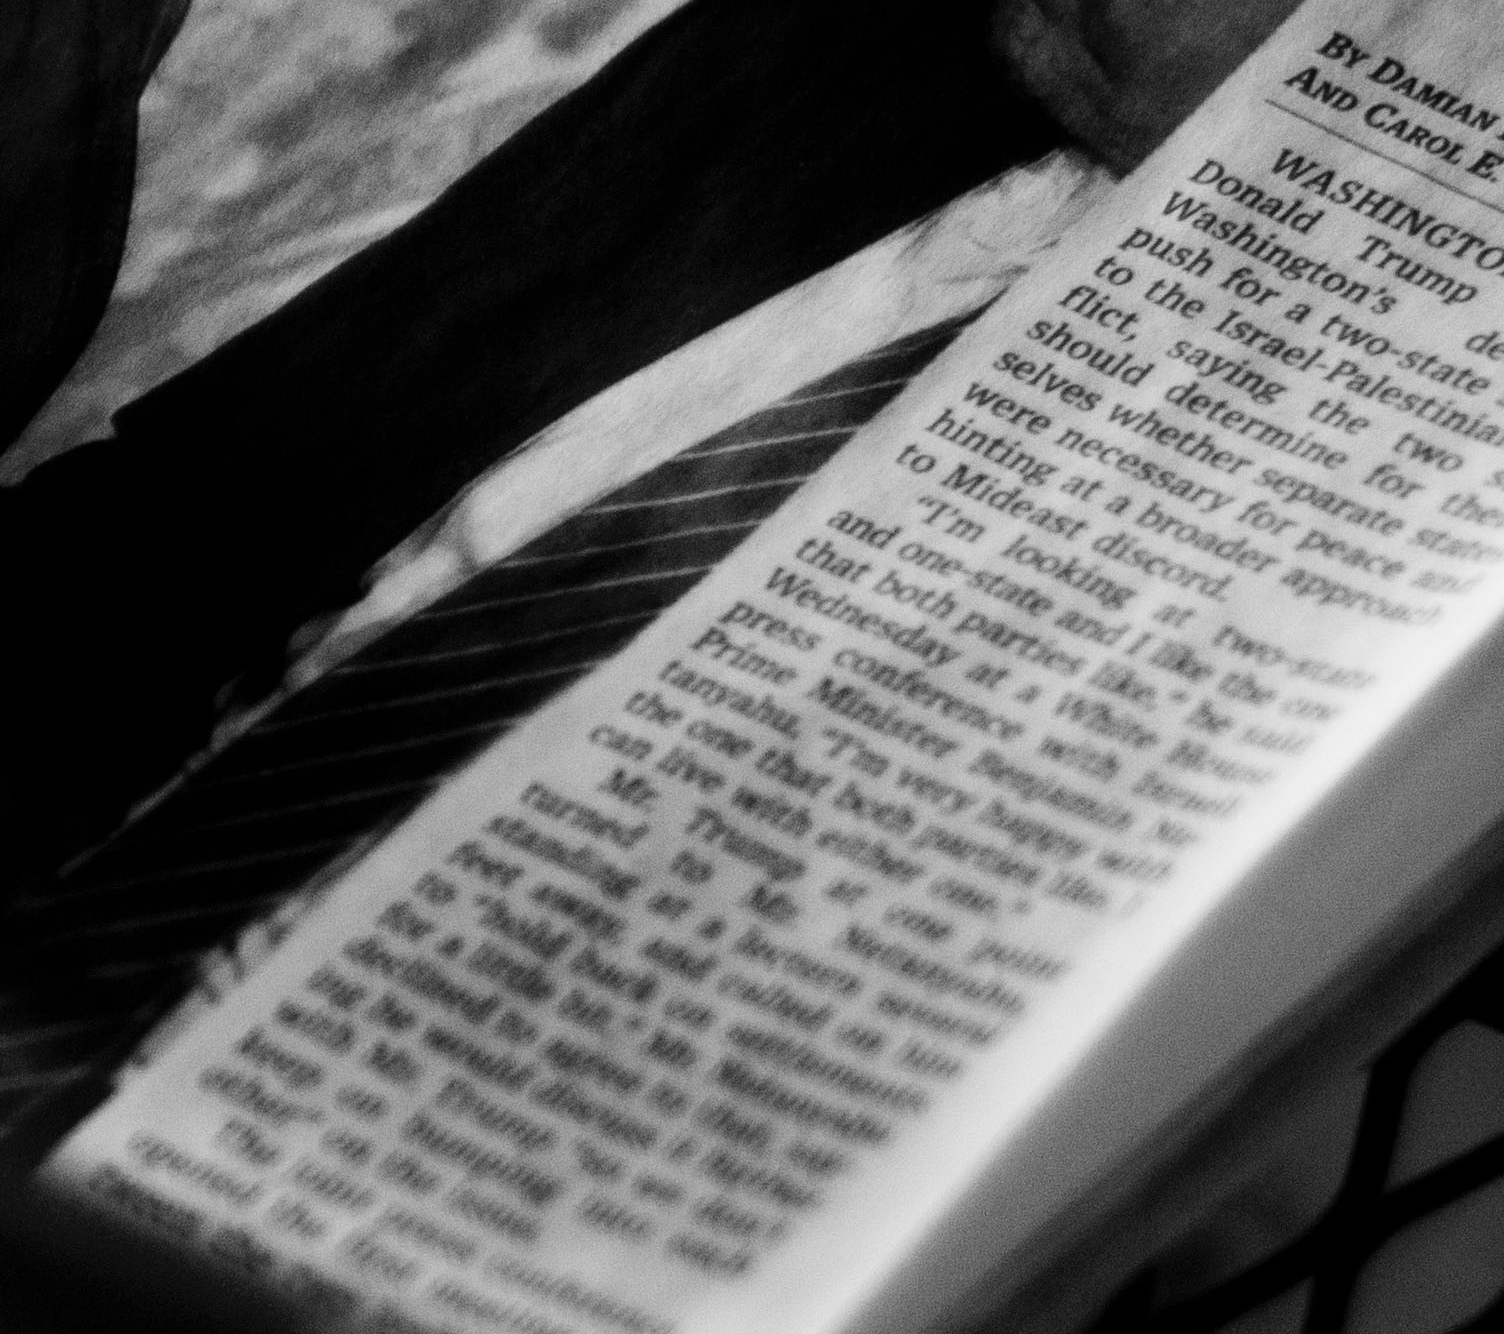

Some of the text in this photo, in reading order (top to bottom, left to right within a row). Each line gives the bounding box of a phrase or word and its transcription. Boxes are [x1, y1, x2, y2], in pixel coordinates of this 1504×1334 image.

[1363, 103, 1465, 165] CAROL
[1366, 56, 1502, 133] DAMIAN
[1161, 190, 1398, 315] Washington's
[1188, 157, 1479, 305] Donald Trump
[1271, 147, 1504, 275] WASHINGTO
[1057, 284, 1465, 472] flict, saying the two
[1093, 255, 1135, 286] to
[1143, 278, 1206, 319] the
[1212, 307, 1504, 449] Israel-Palestinia
[1117, 226, 1214, 277] push
[1218, 265, 1282, 306] for
[1283, 302, 1313, 324] a
[1319, 313, 1491, 395] two-state
[963, 381, 1298, 533] were necessary for
[992, 350, 1405, 535] selves whether separate
[1025, 319, 1425, 499] should determine for
[895, 443, 1234, 603] to Mideast discord.
[924, 408, 1280, 571] hinting at a broader
